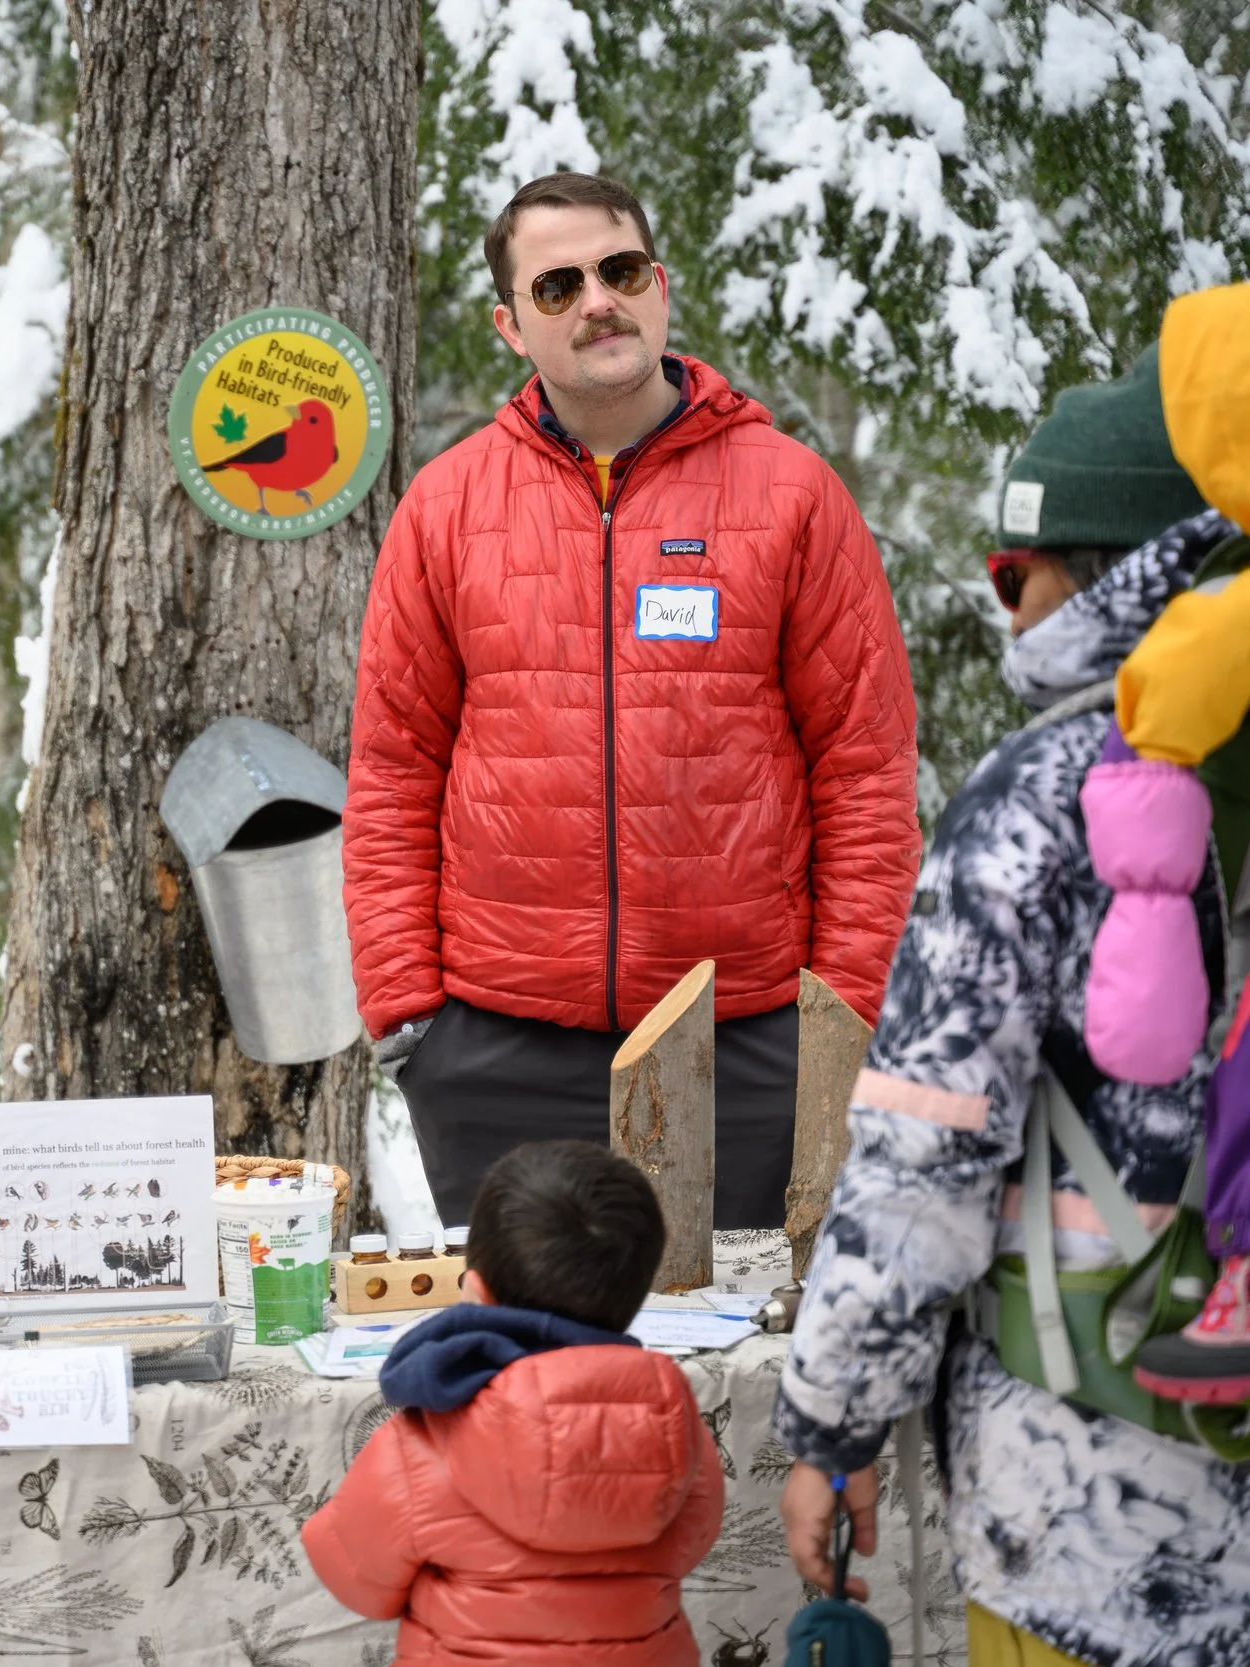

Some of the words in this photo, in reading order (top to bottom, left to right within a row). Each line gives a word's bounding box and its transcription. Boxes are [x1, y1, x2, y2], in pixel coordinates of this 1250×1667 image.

[196, 316, 332, 374] PARTICIPATING
[337, 338, 382, 430] PRODUCER
[266, 339, 339, 378] Produced
[216, 370, 281, 407] Habitats
[237, 353, 253, 373] in
[255, 361, 352, 410] Bird-friendly
[665, 546, 702, 554] patagonia
[646, 600, 698, 634] David
[3, 1146, 30, 1156] mine:
[32, 1144, 56, 1154] what
[58, 1143, 83, 1153] birds
[84, 1142, 100, 1152] tell
[102, 1143, 113, 1151] us
[116, 1140, 143, 1151] about
[145, 1139, 172, 1150] forest
[175, 1138, 206, 1149] health
[11, 1163, 25, 1172] bird
[27, 1162, 51, 1172] species
[53, 1161, 78, 1169] reflects
